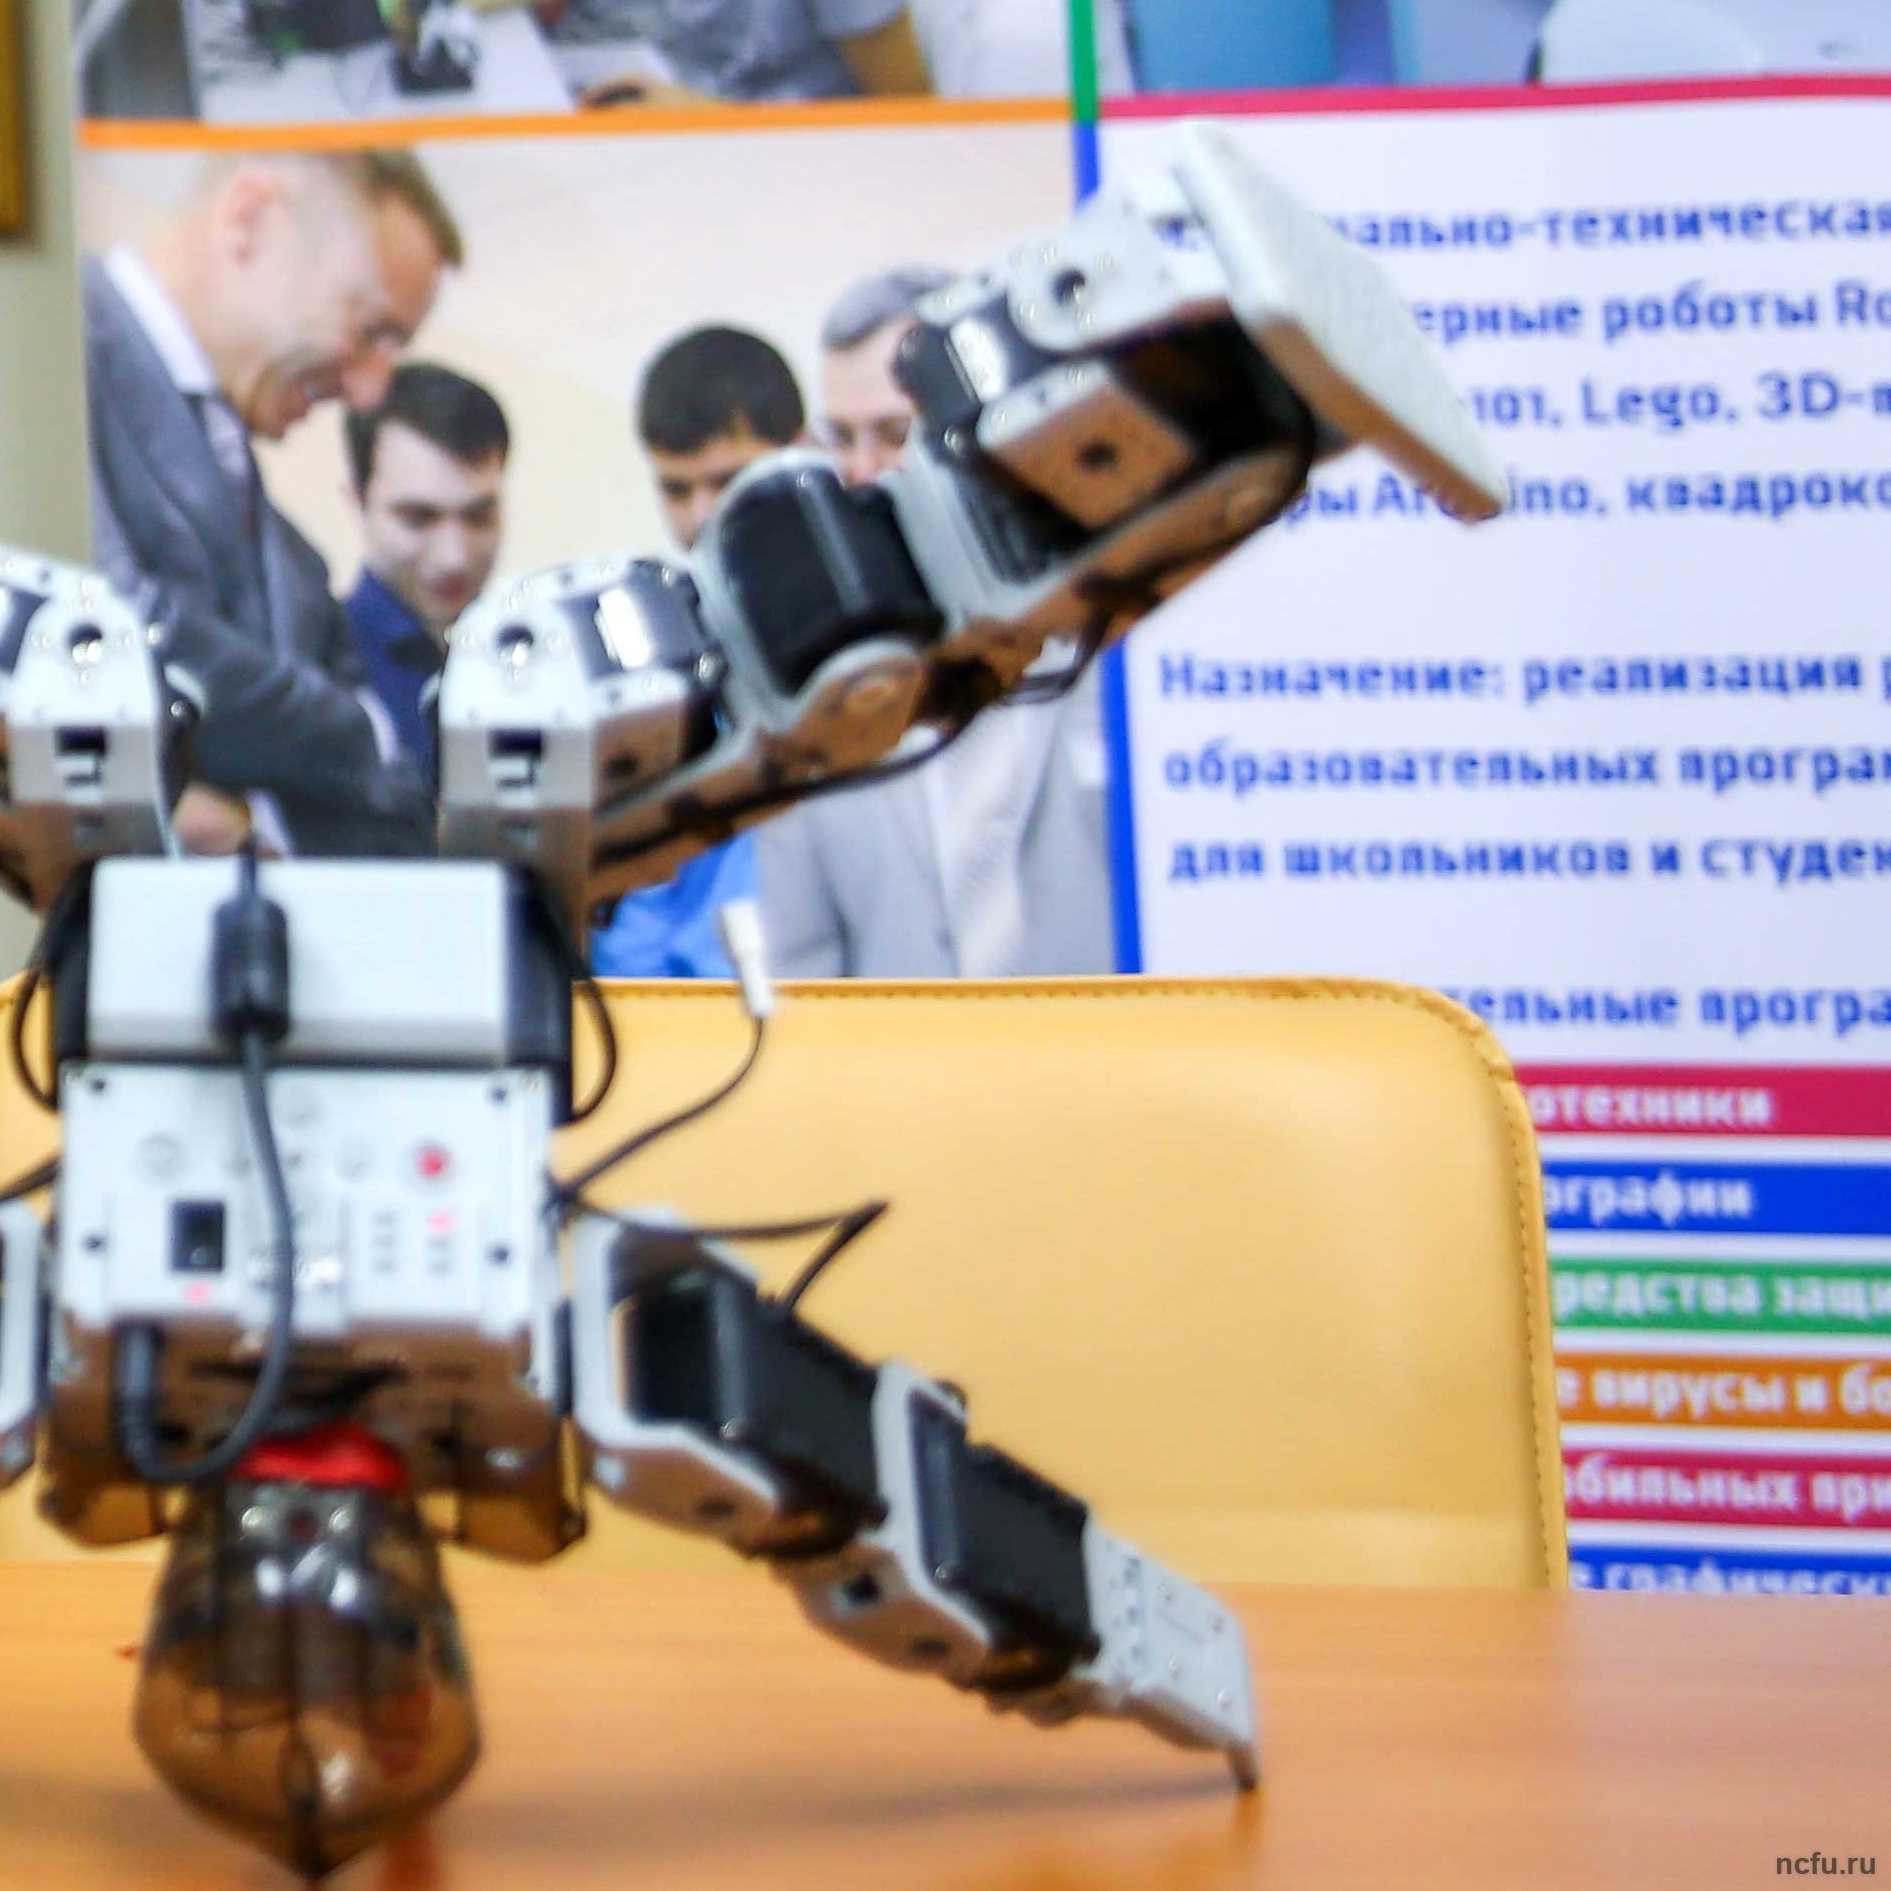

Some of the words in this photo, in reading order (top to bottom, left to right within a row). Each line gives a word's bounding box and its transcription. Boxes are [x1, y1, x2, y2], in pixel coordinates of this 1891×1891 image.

[1604, 277, 1820, 345] роботы
[1371, 464, 1611, 519] Arino,
[1159, 652, 1503, 701] Назначение:
[1521, 654, 1862, 711] реализация
[1163, 737, 1657, 799] образовательных
[1678, 745, 1891, 797] програ
[1168, 837, 1265, 887] для
[1282, 839, 1632, 878] школьников
[1650, 839, 1682, 877] и
[1592, 1371, 1784, 1421] вирусы
[1795, 1375, 1827, 1415] и
